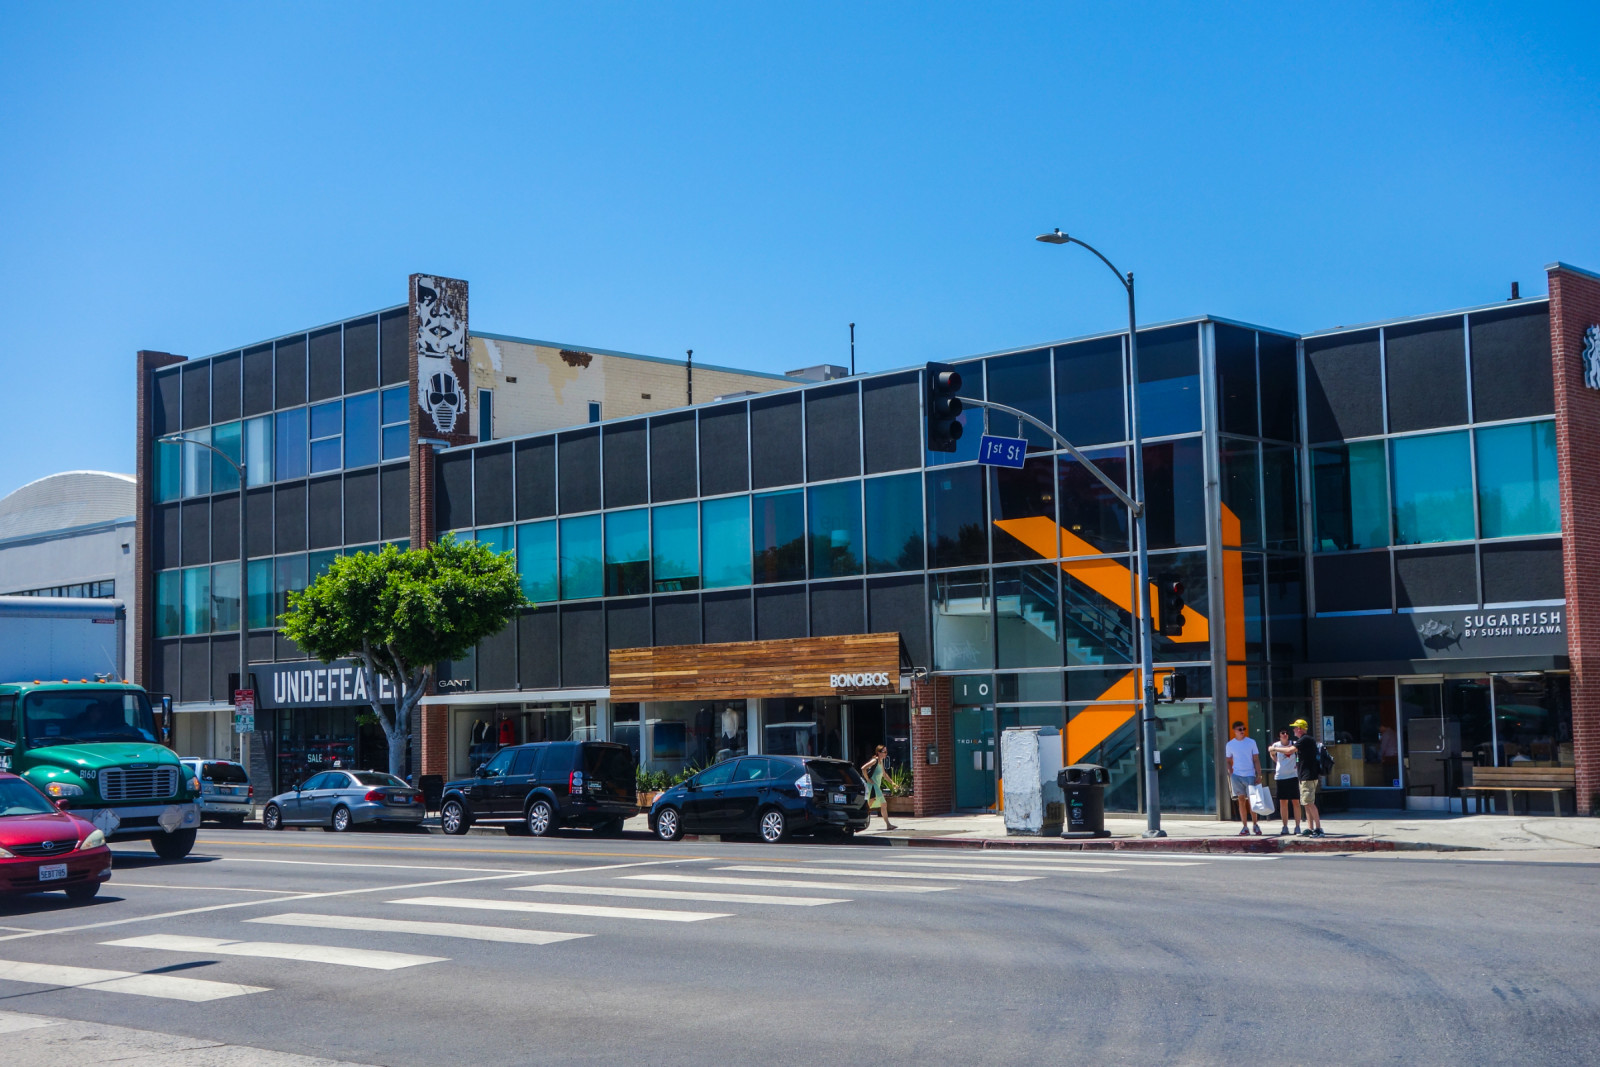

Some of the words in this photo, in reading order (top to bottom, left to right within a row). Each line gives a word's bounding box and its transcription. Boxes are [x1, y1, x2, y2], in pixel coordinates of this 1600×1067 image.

[987, 441, 1002, 459] 1st
[1007, 445, 1020, 460] St
[1464, 611, 1561, 628] SUGARFISH
[1465, 629, 1477, 637] BY
[1481, 627, 1512, 637] SUSHI
[1516, 625, 1562, 635] NOZAWA
[274, 667, 406, 703] UNDEFEAE
[438, 679, 470, 688] GANT
[830, 672, 889, 688] BONOBOS
[307, 753, 323, 763] SALE
[80, 769, 97, 779] B160
